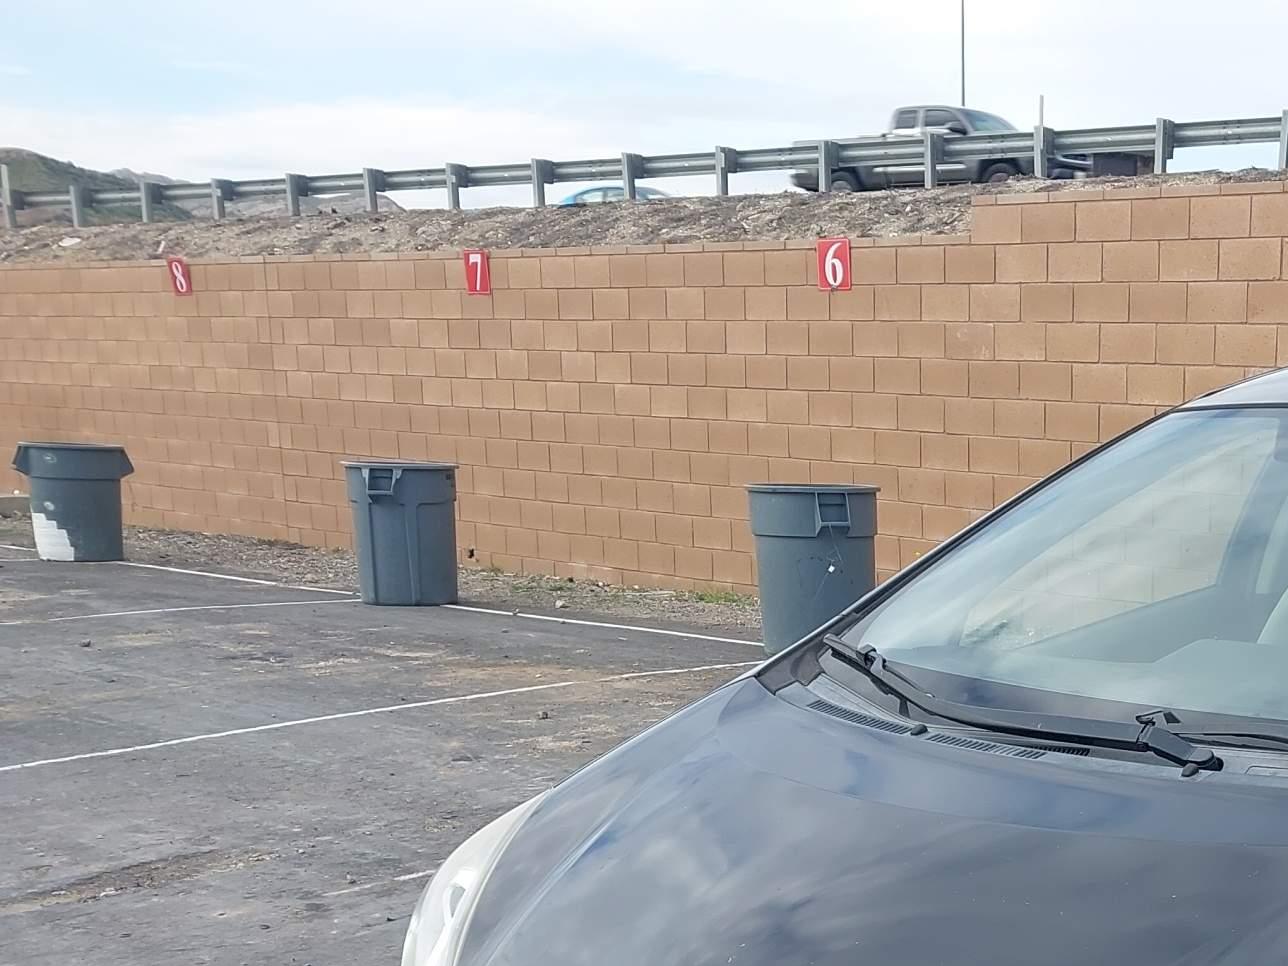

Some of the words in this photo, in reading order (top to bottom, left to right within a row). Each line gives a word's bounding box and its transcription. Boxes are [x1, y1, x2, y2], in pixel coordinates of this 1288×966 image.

[171, 261, 187, 293] 8
[468, 254, 482, 291] 7
[824, 242, 842, 285] 6
